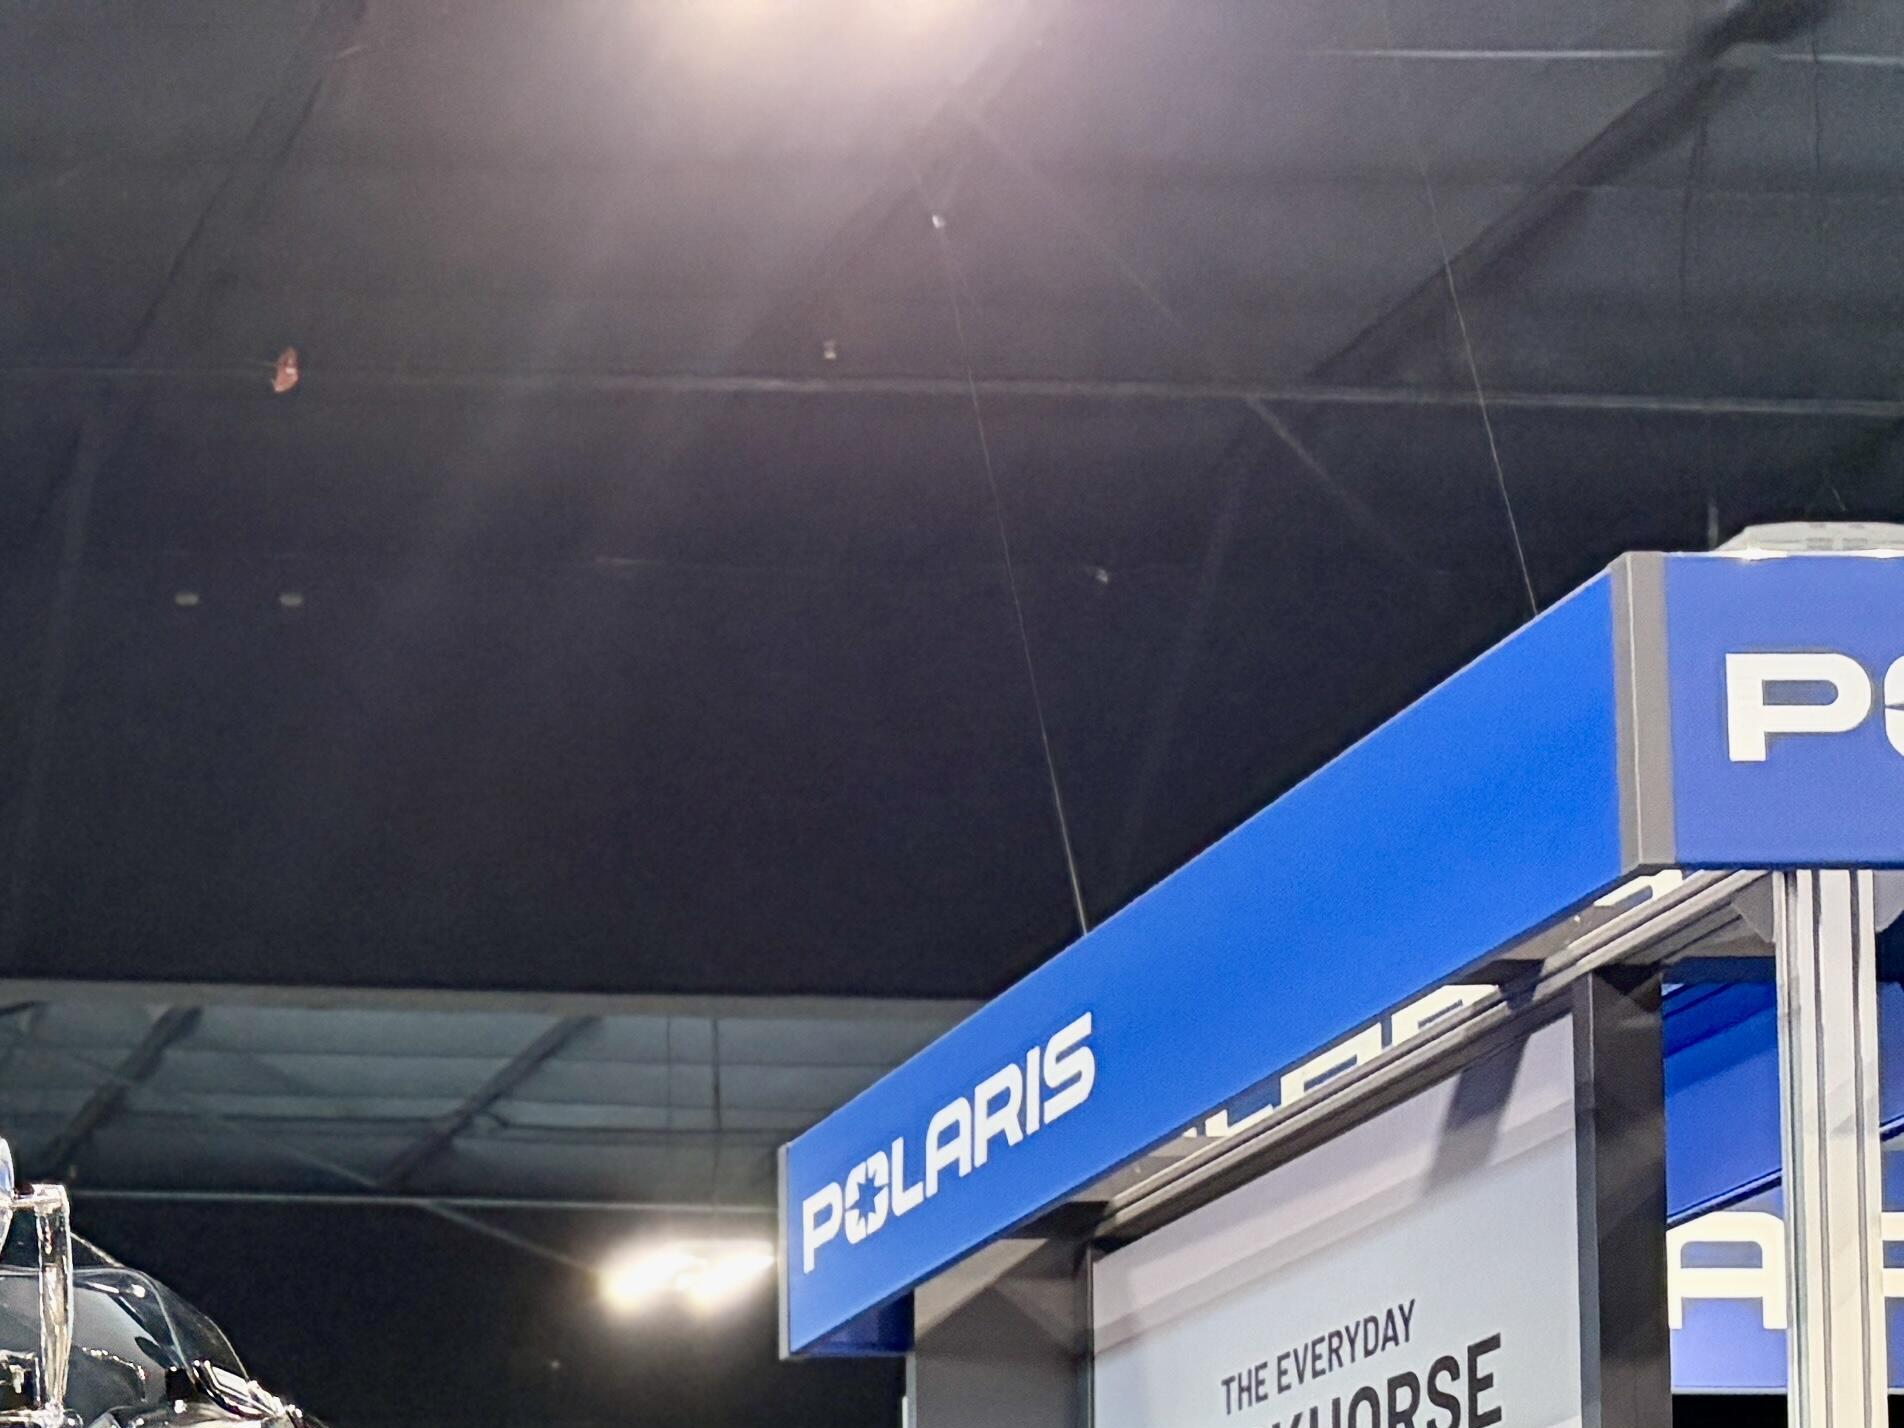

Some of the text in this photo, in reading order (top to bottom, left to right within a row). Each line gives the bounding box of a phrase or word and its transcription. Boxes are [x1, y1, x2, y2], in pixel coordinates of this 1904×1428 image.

[1725, 653, 1904, 762] P
[802, 1011, 1096, 1274] POLARIS
[1221, 1298, 1415, 1415] THE EVERYDAY
